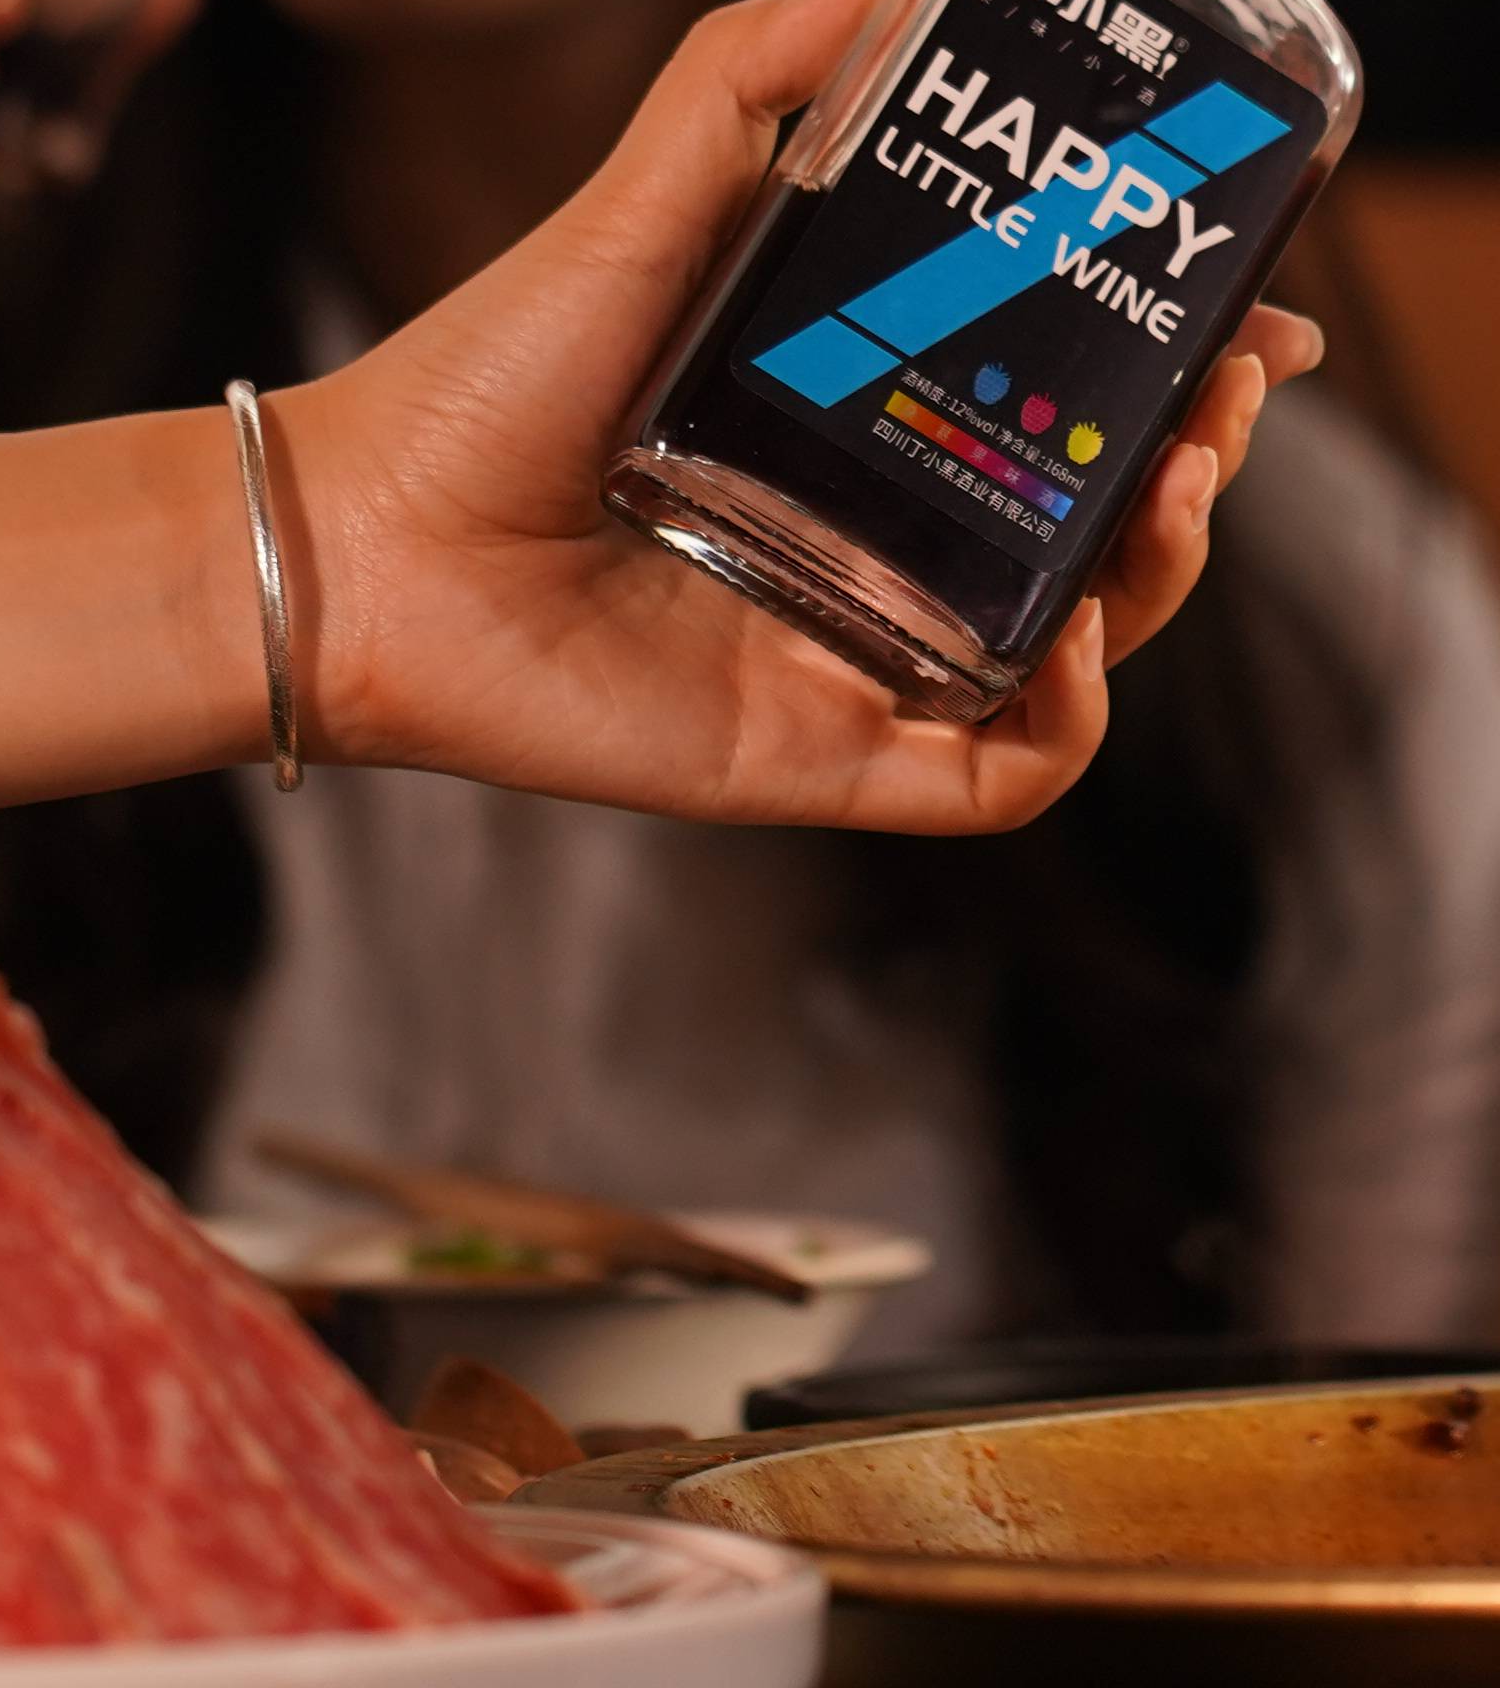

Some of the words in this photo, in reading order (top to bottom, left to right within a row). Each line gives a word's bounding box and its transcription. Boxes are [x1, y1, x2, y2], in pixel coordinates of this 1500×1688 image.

[875, 126, 1036, 249] LITTLE
[1052, 233, 1185, 344] WINE
[905, 47, 1235, 279] HAPPY
[872, 417, 1056, 544] 四川丁小黑酒业有限公司
